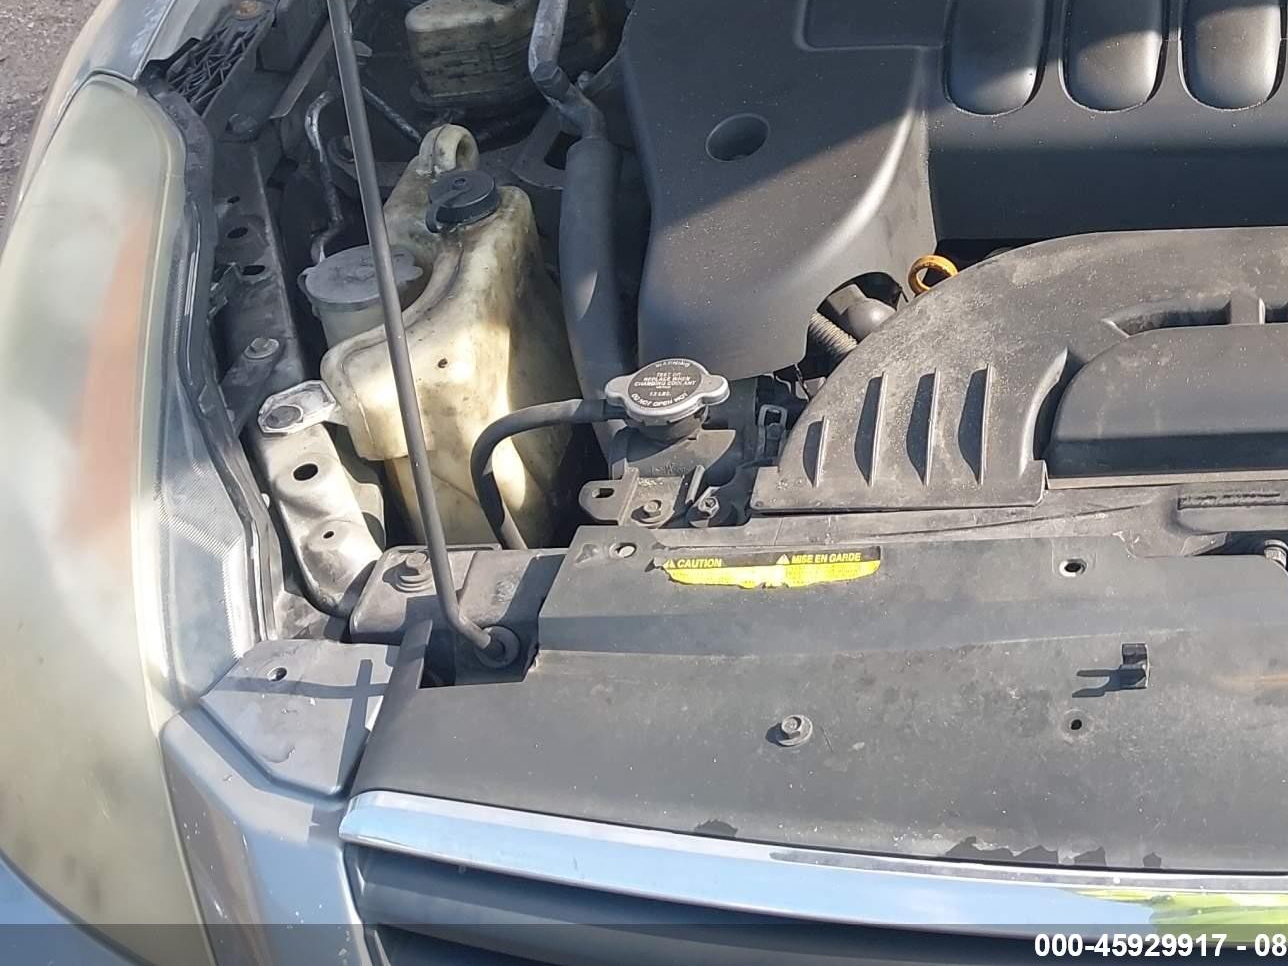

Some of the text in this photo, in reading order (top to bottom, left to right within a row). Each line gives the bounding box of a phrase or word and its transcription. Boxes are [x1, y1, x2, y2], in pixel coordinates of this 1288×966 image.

[639, 398, 652, 406] NOT
[652, 399, 673, 407] OPEN
[677, 558, 723, 569] CAUTION
[791, 552, 862, 564] MISE EN GARDE
